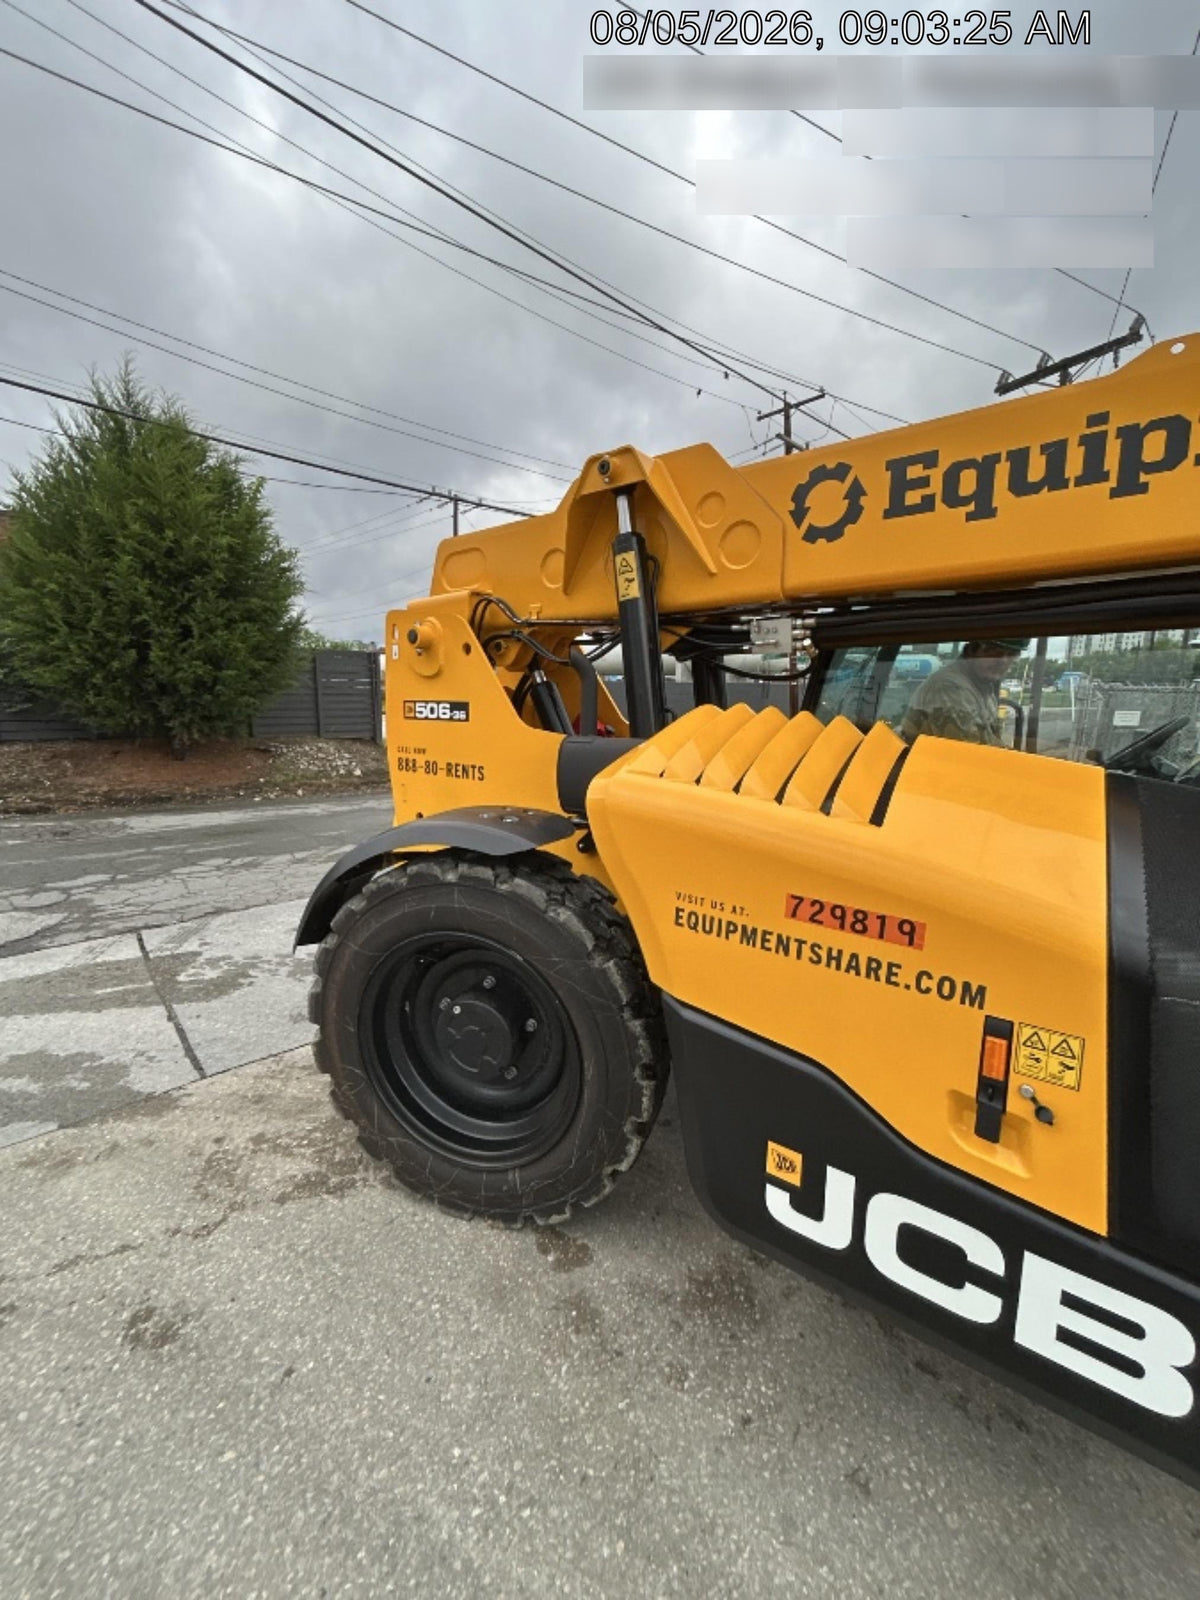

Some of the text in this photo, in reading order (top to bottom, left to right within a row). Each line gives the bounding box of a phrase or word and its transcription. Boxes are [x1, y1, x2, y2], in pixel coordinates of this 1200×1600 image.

[882, 410, 1200, 523] Equip
[397, 757, 484, 781] 888-80-RENTS
[675, 891, 705, 907] VISIT
[710, 900, 726, 912] US
[789, 894, 918, 947] 729819
[674, 906, 987, 1010] EQUIPMENTSHARE.COM
[765, 1164, 1197, 1419] JCB
